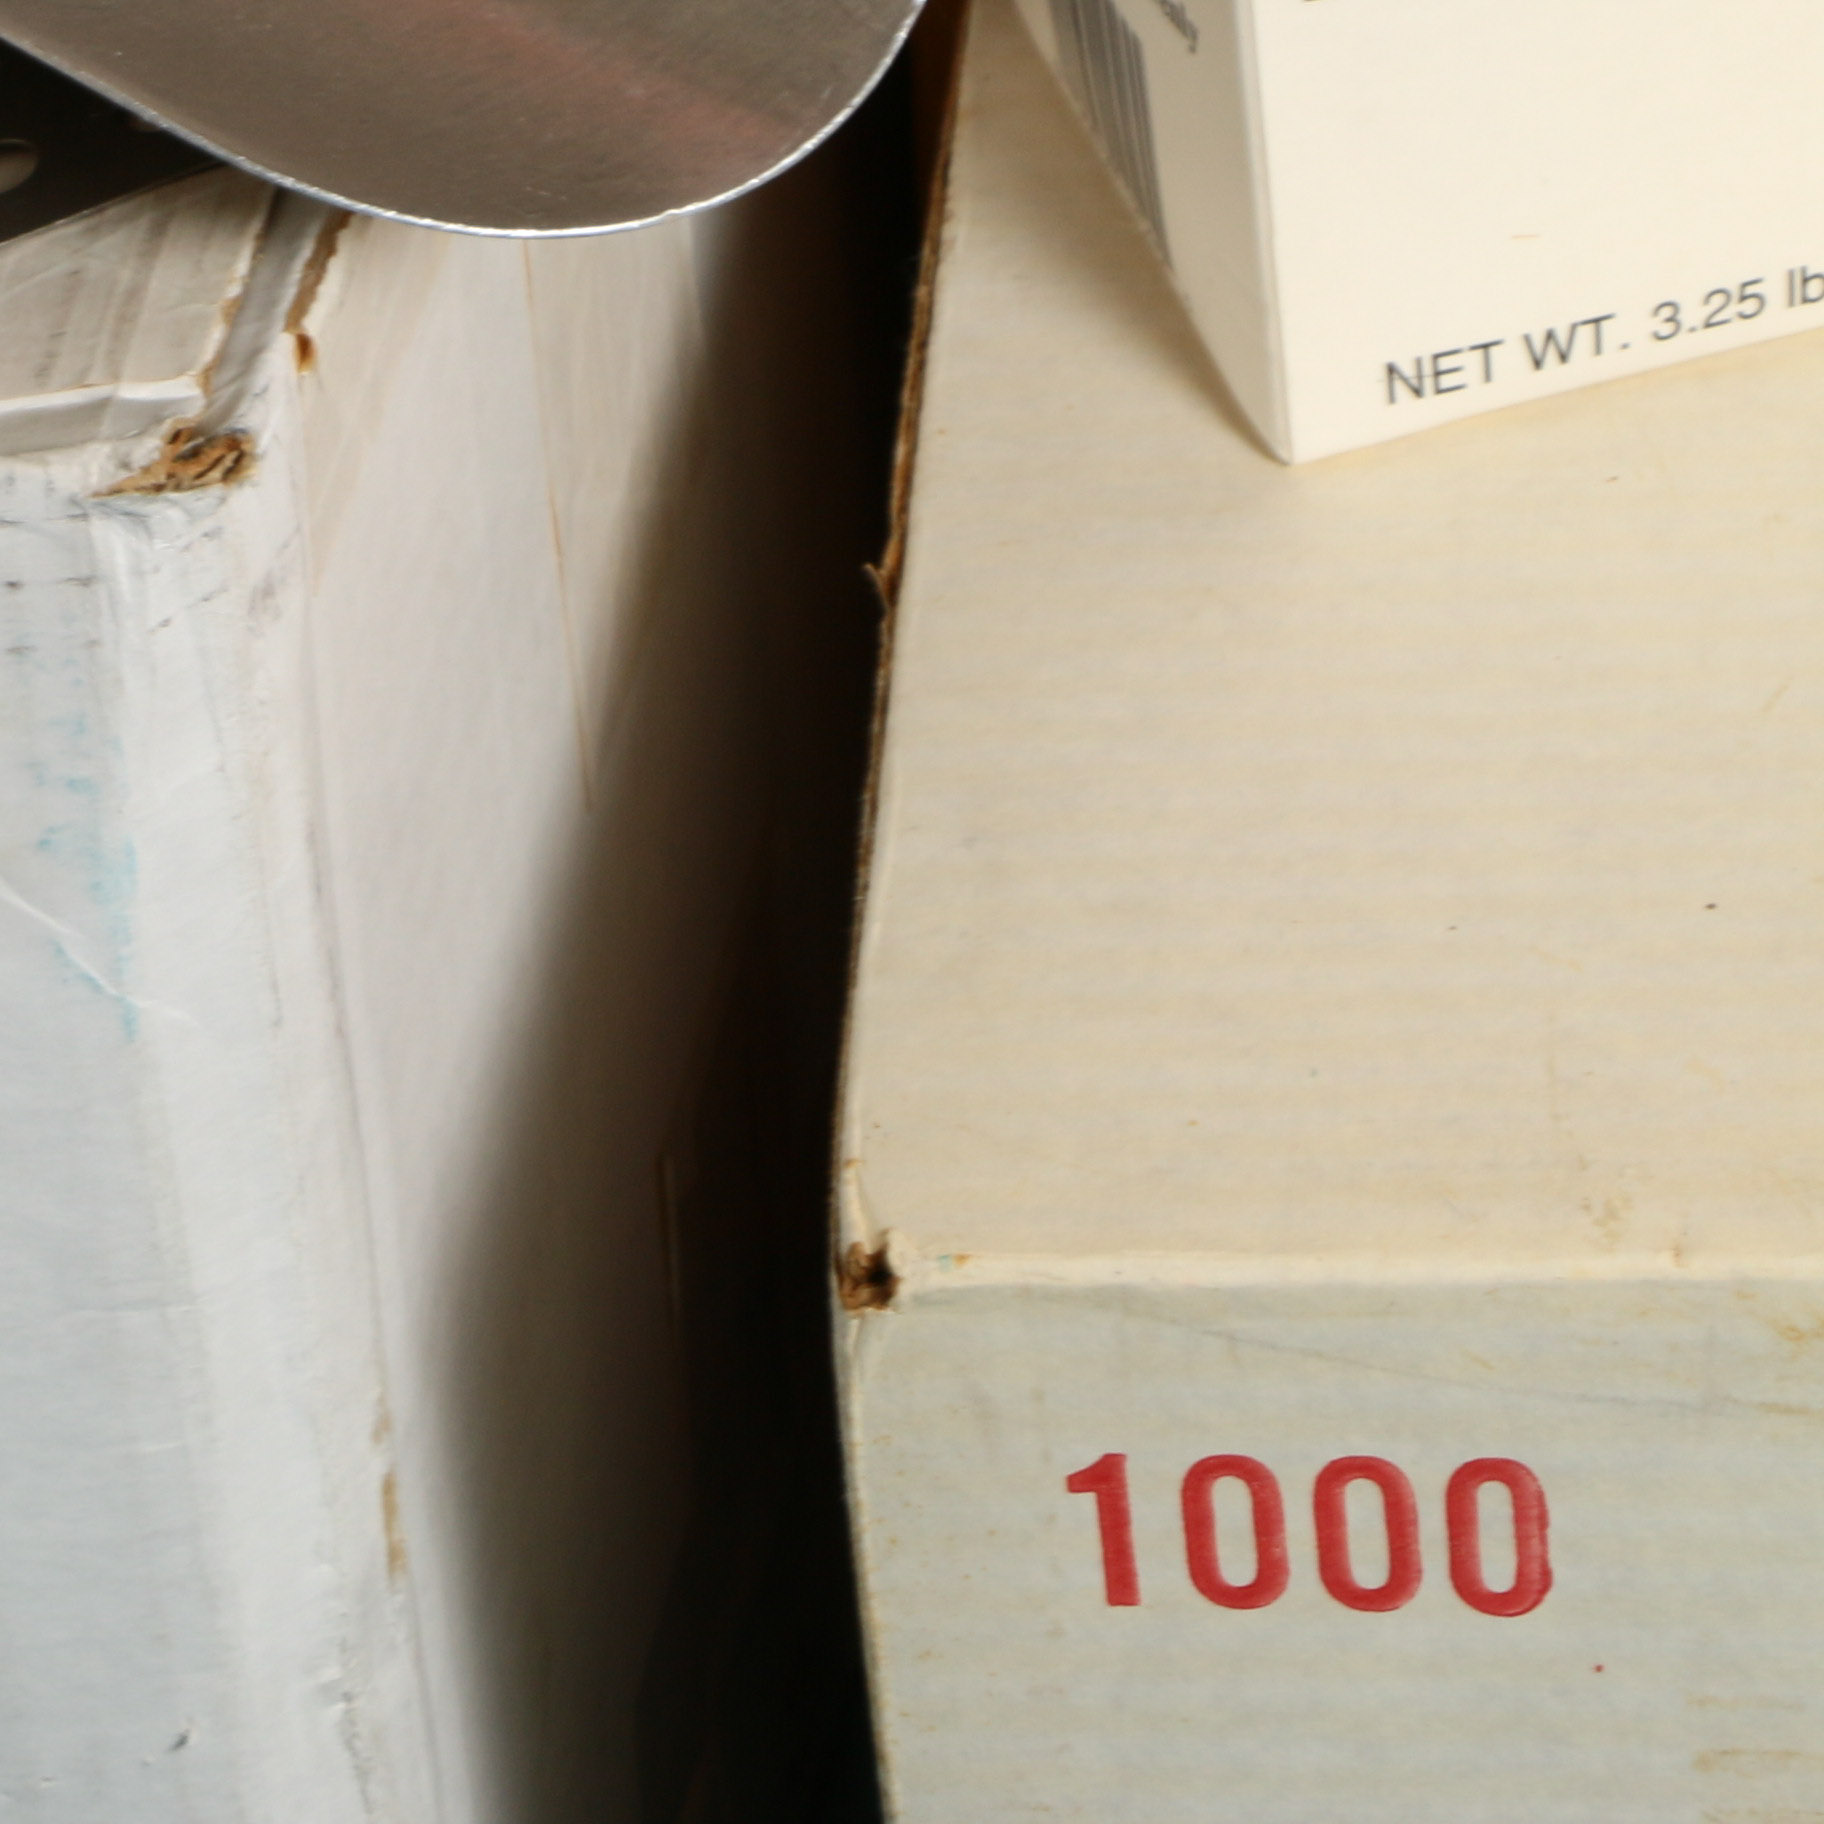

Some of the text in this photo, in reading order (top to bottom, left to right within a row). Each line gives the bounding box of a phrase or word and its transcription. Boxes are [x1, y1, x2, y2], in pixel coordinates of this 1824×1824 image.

[1384, 339, 1505, 405] NET
[1522, 312, 1633, 372] WT.
[1650, 277, 1767, 342] 3.25
[1065, 1452, 1553, 1617] 1000
